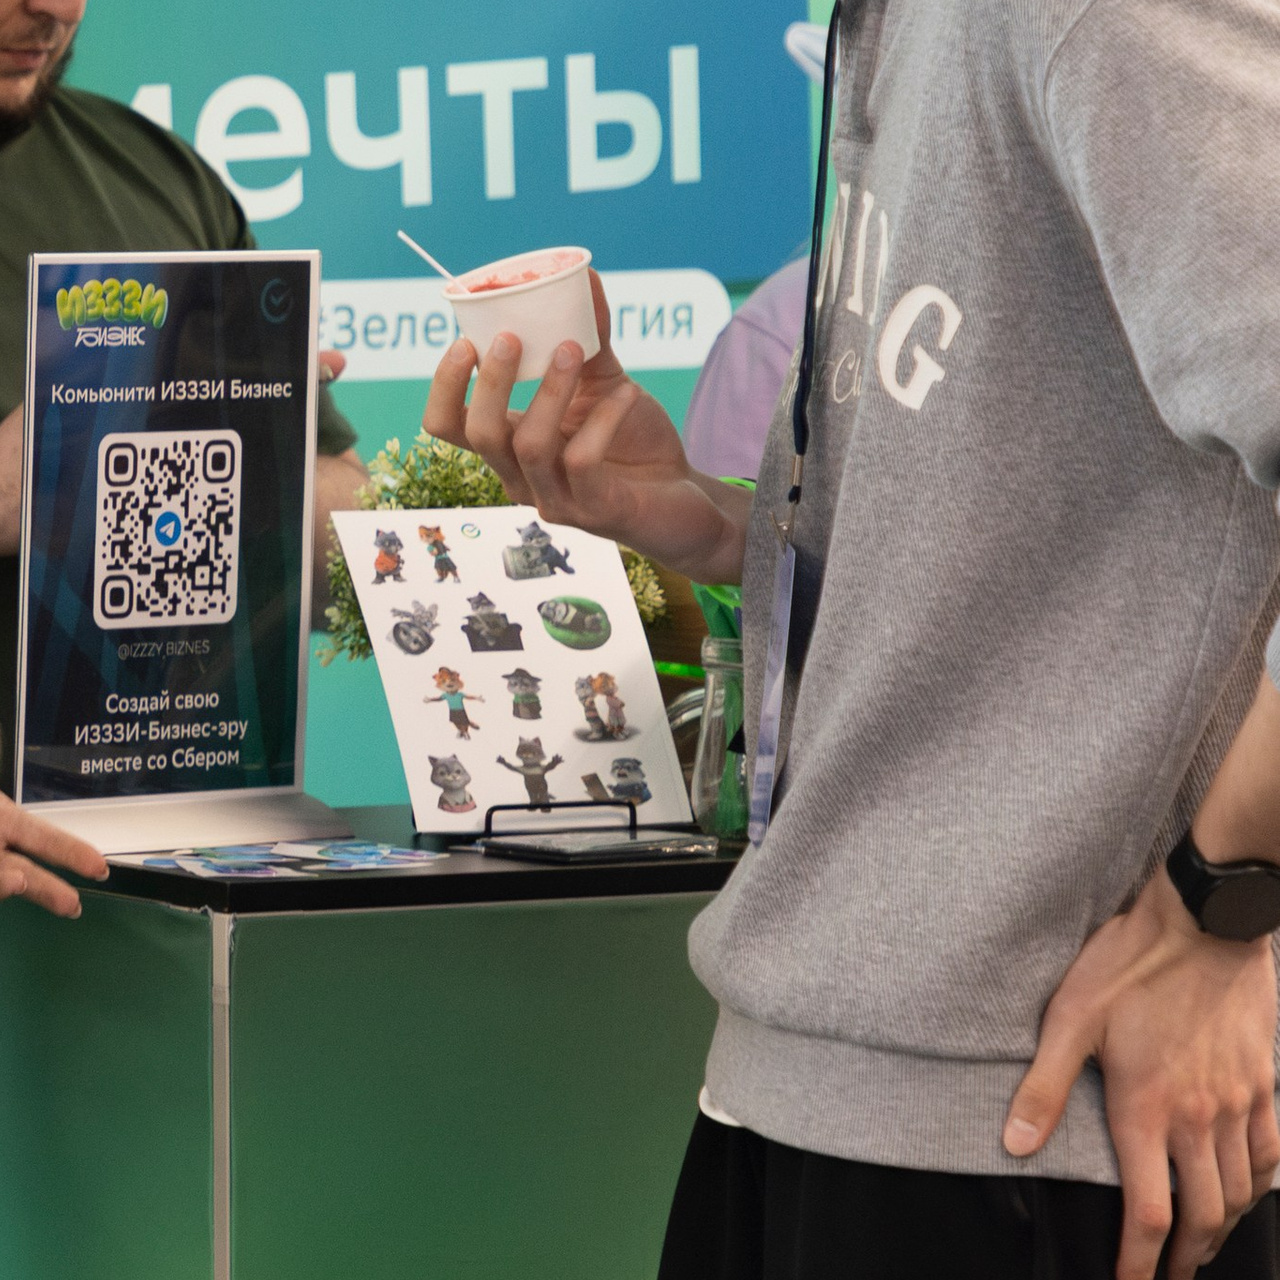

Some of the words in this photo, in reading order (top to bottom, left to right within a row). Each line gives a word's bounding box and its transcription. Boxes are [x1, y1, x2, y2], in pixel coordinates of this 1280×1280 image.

[131, 44, 702, 223] ечты
[51, 383, 155, 405] Комьюнити
[161, 379, 225, 402] ИЗЗЗИ
[230, 378, 293, 401] Бизнес
[105, 689, 170, 715] Создай
[174, 691, 220, 710] свою
[74, 719, 249, 746] ИЗЗЗИ-Бизнес-эру
[80, 755, 143, 776] вместе
[146, 753, 168, 771] со
[171, 746, 240, 771] Сбером
